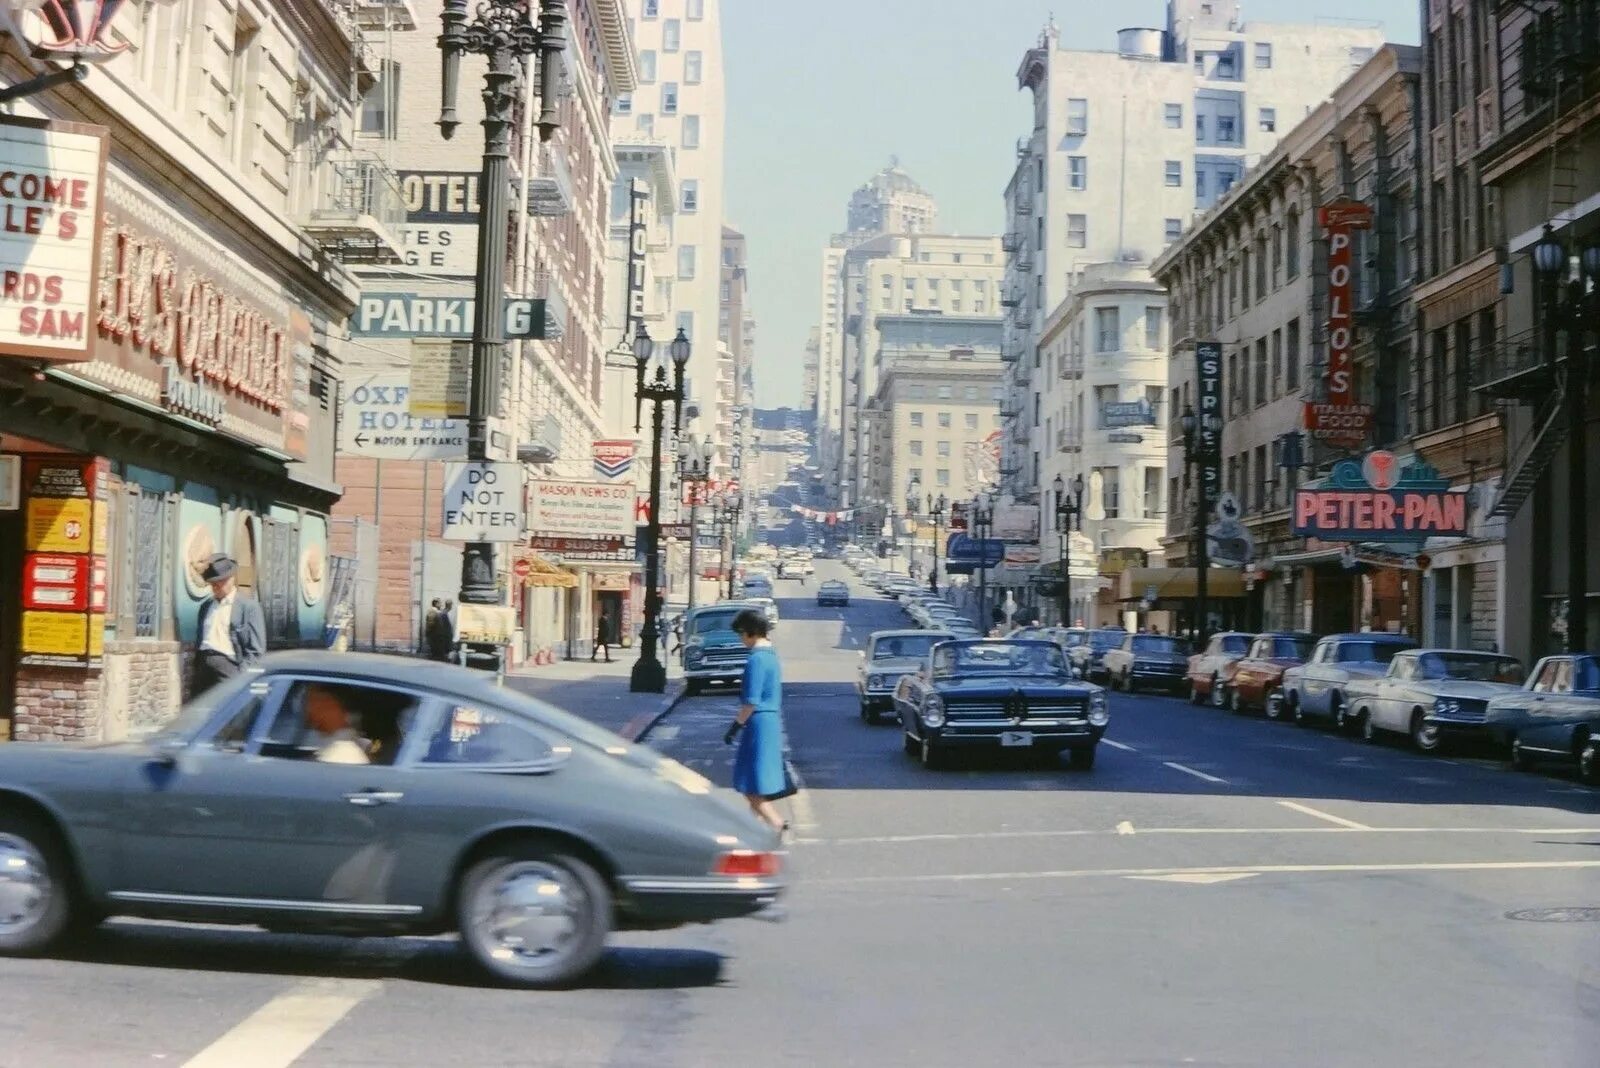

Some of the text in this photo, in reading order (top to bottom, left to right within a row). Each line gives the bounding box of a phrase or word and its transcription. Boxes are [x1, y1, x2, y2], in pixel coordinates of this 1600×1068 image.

[0, 171, 89, 210] COME
[5, 204, 78, 241] LE'S
[632, 197, 646, 347] HOTEL
[4, 270, 64, 305] RDS
[19, 306, 84, 341] SAM
[360, 298, 532, 335] PARKIG
[1330, 233, 1351, 394] POLO'S
[359, 411, 457, 430] HOTEL
[1202, 360, 1218, 481] STRES
[1313, 404, 1371, 416] ITALIAN
[1317, 415, 1366, 428] FOOD
[374, 436, 463, 448] MOTOR ENTRANCE
[469, 470, 497, 484] DO
[461, 490, 504, 505] NOT
[540, 485, 631, 500] MASON NEWS CO.
[446, 510, 516, 526] ENTER
[1295, 491, 1466, 531] PETER-PAN
[533, 539, 609, 551] ART SLIDES
